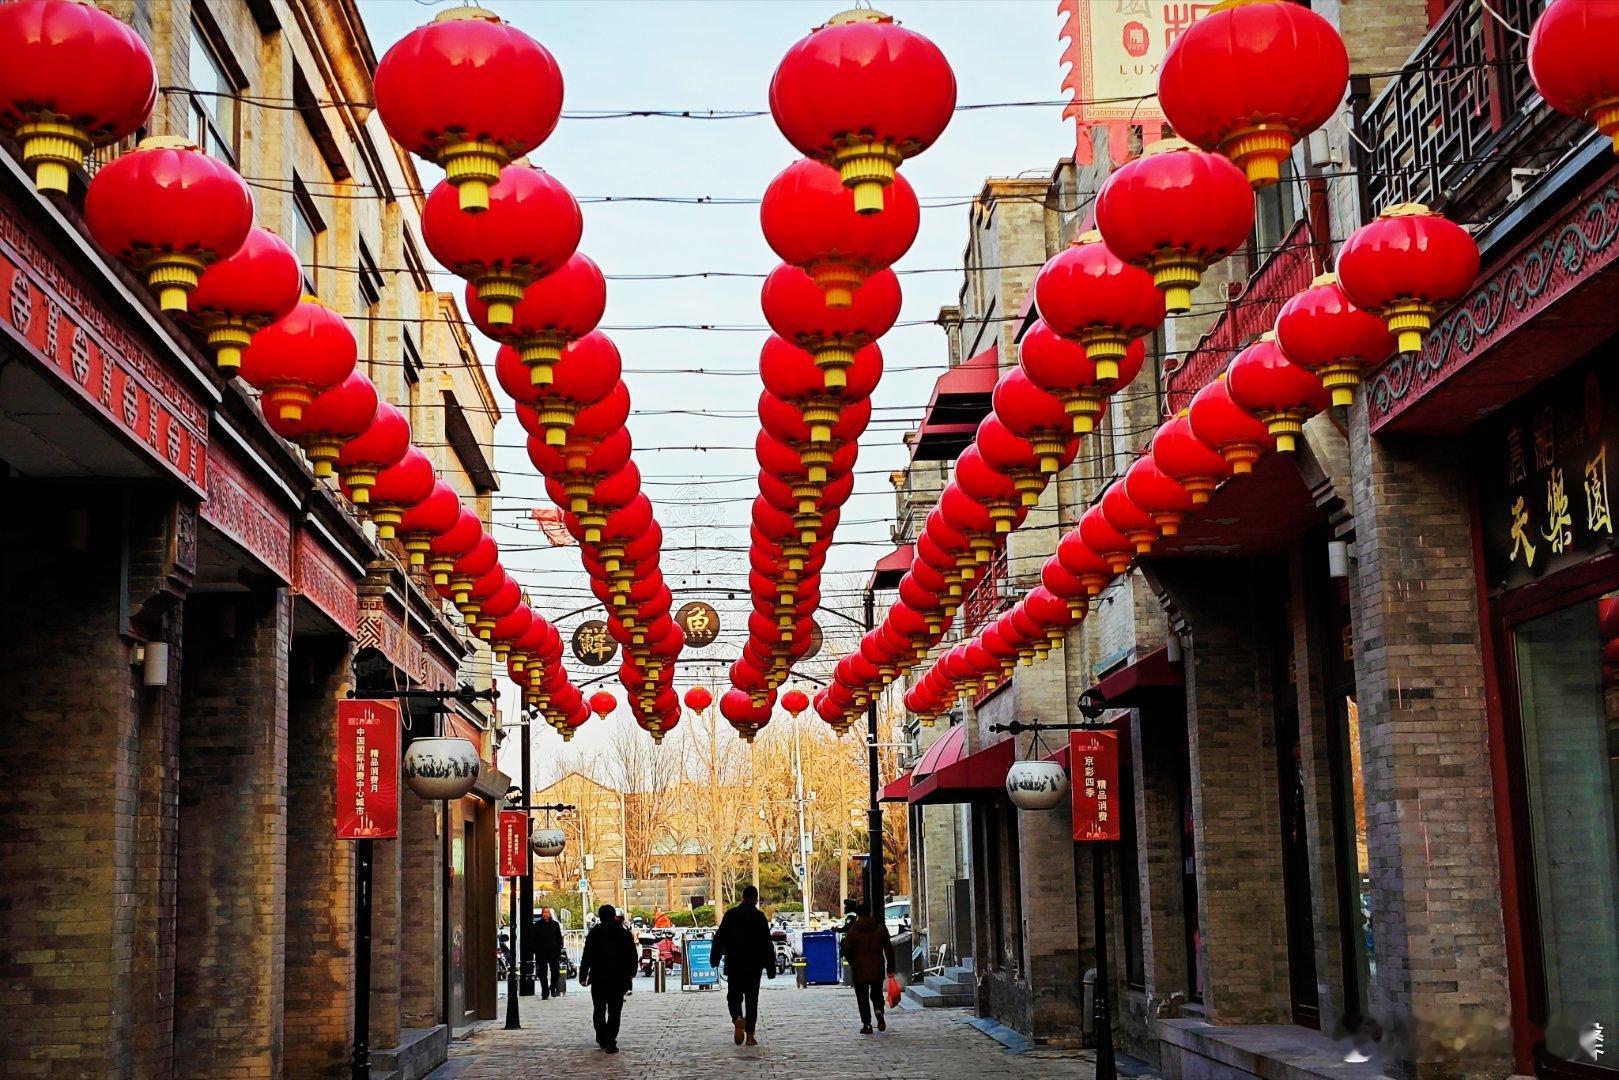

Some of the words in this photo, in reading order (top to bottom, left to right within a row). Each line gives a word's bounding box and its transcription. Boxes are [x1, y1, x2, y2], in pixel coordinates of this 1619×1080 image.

[577, 625, 612, 661] 鮮
[355, 728, 365, 815] 中国国际消费中心城市
[370, 749, 379, 793] 精品消费月
[1084, 756, 1096, 798] 京彩四季
[1096, 779, 1108, 822] 精品消费
